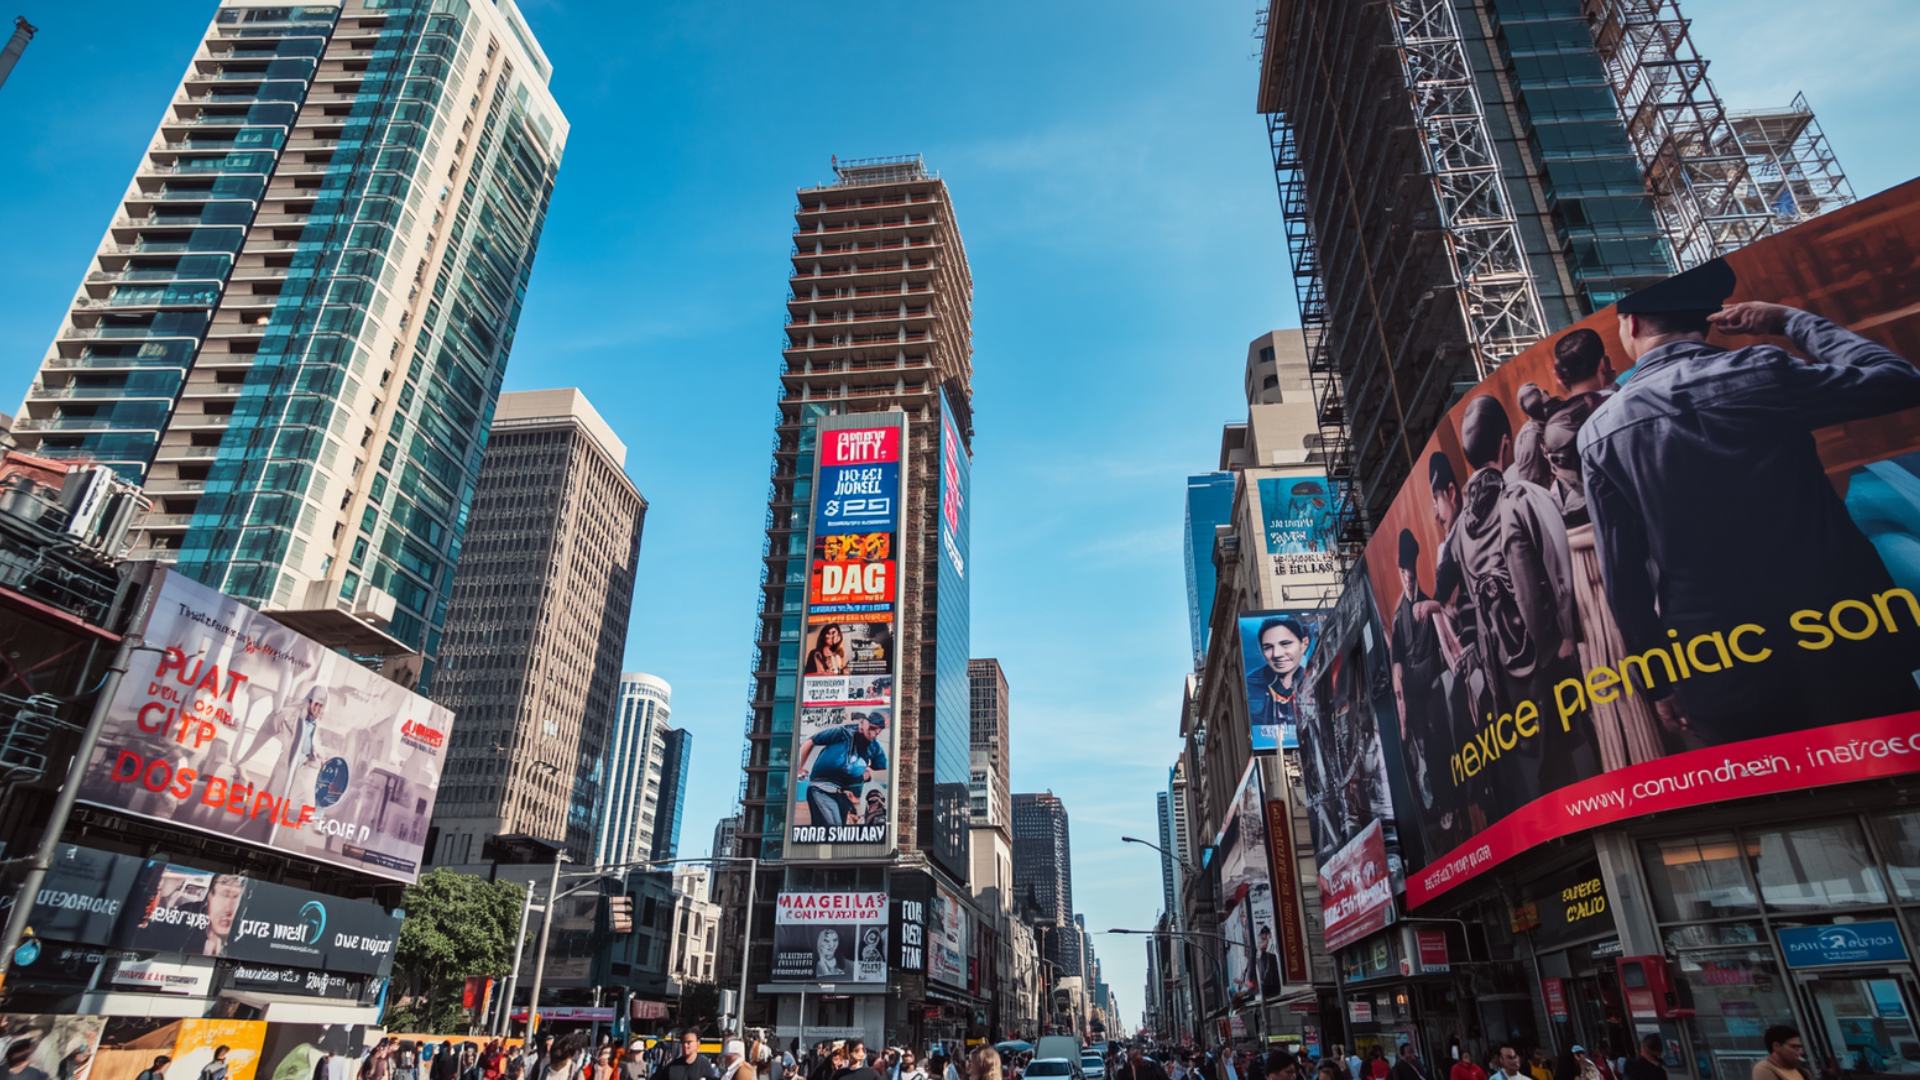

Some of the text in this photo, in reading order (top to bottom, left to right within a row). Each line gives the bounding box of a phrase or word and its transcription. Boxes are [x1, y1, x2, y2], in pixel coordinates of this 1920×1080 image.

[822, 563, 886, 595] DAG
[1554, 622, 1773, 732] pemiac
[1789, 587, 1920, 650] son
[110, 749, 198, 800] DOS
